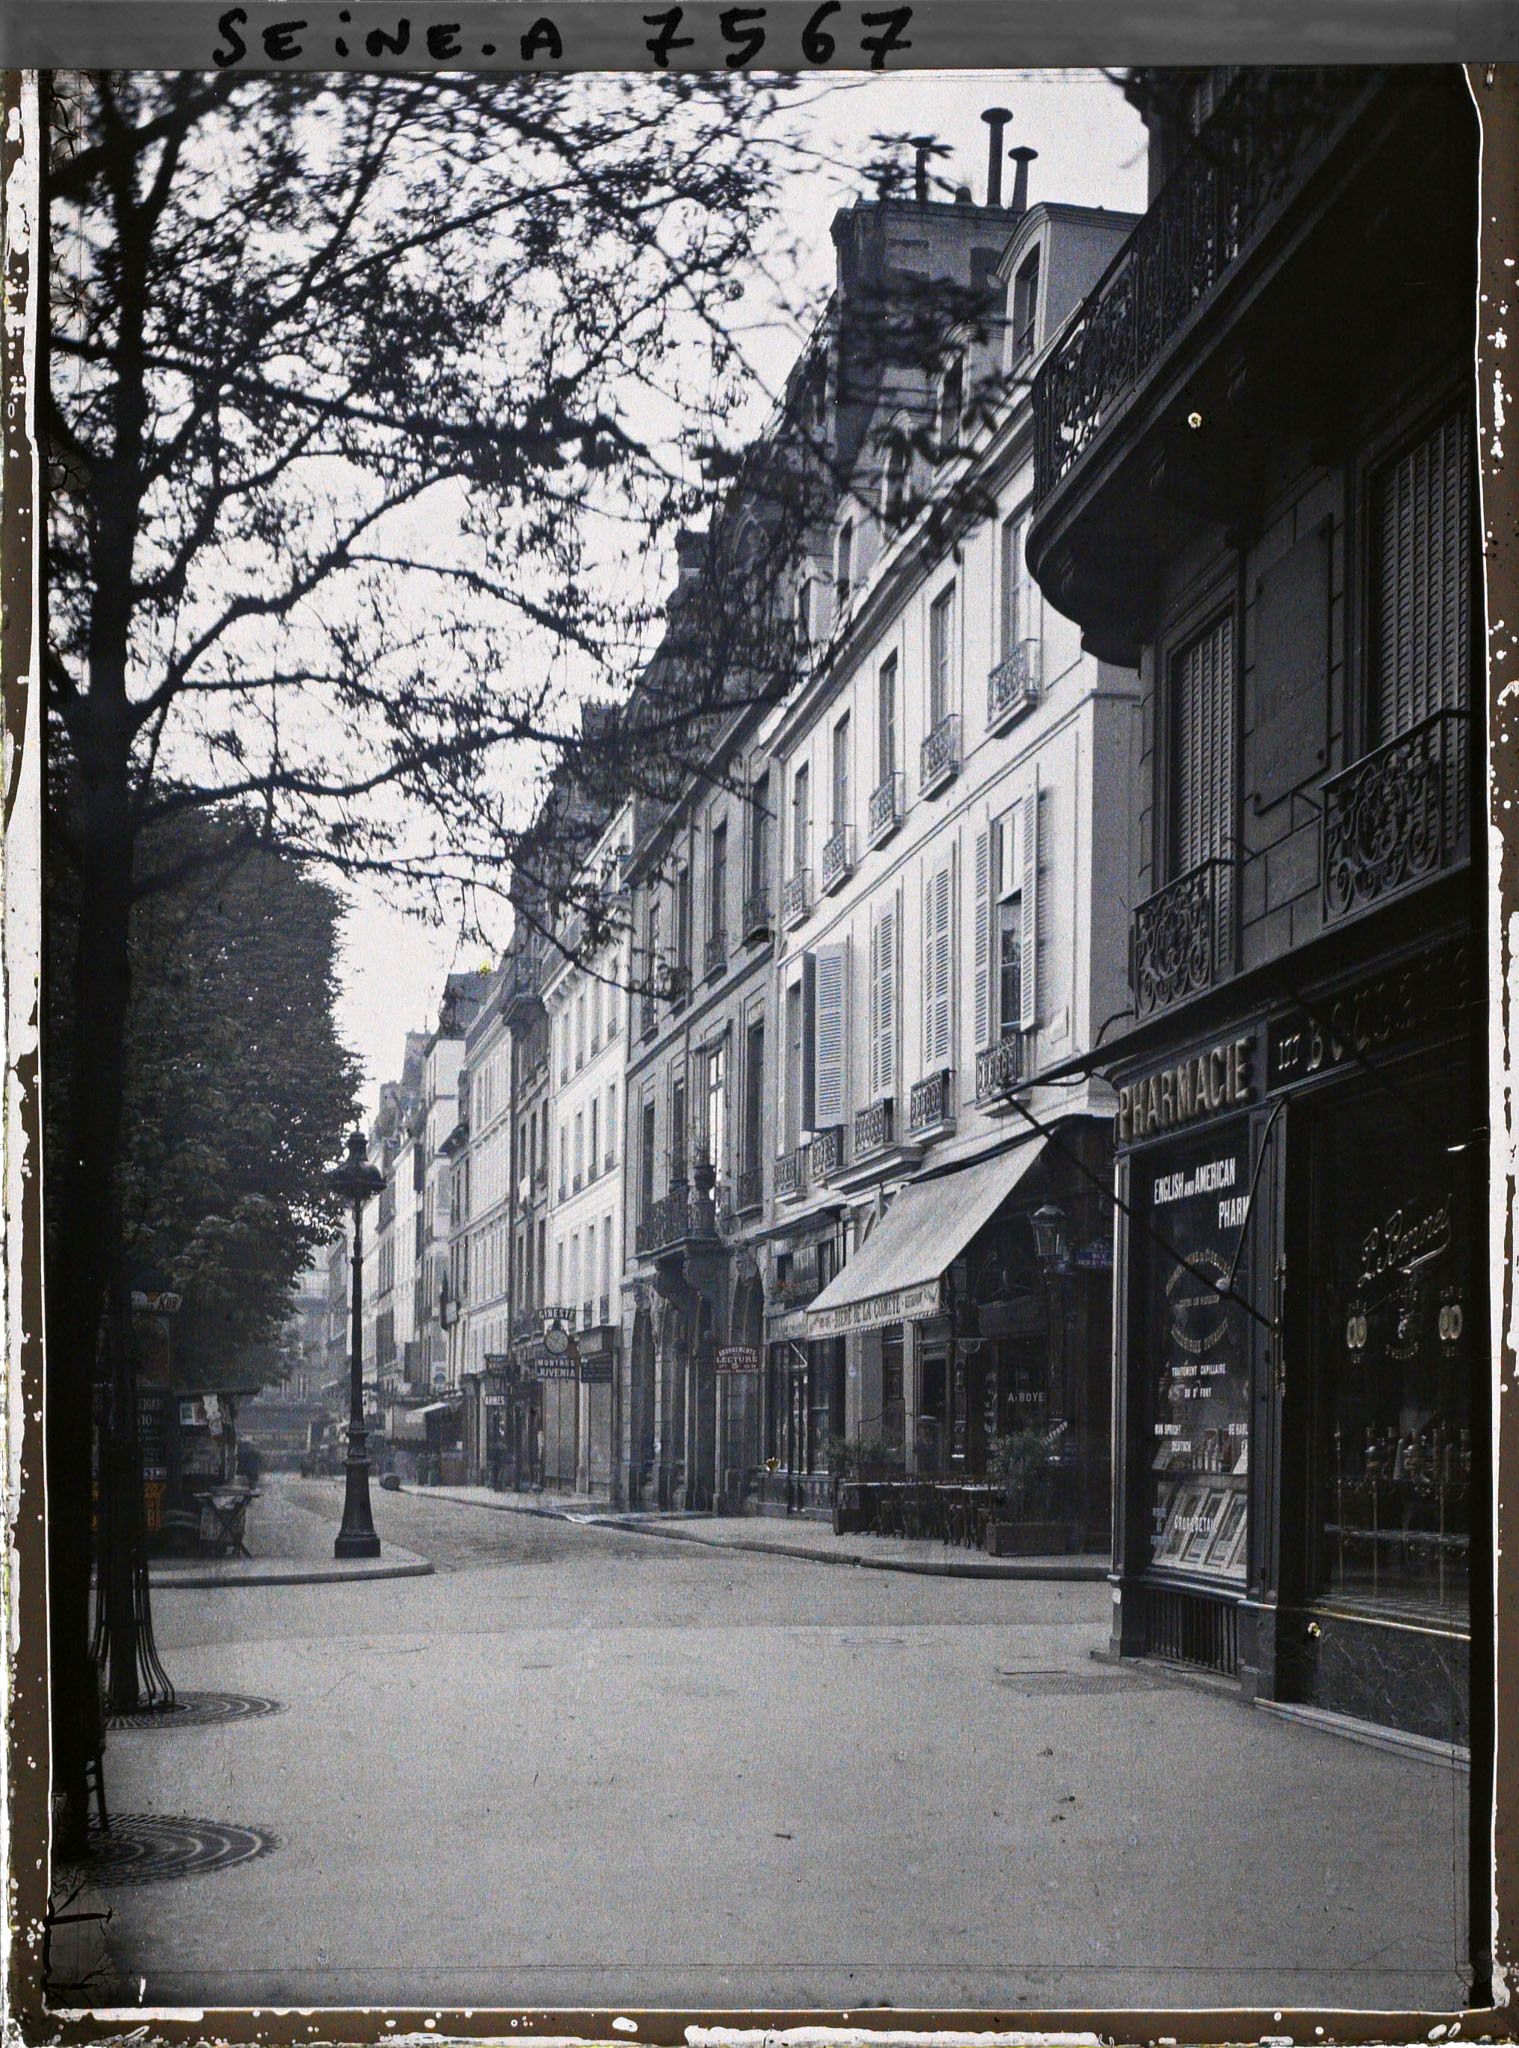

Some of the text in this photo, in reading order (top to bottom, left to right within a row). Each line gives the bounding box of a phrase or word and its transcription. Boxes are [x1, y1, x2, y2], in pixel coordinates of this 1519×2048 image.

[643, 2, 912, 70] 7567
[1119, 1036, 1253, 1141] PHARMACIE
[1154, 1171, 1184, 1205] ENGLISH
[1194, 1157, 1236, 1194] AMERICAN
[537, 1359, 575, 1367] MONTRES
[716, 1356, 758, 1364] LECTURE
[537, 1368, 576, 1377] JUVENIA
[1200, 1363, 1226, 1375] CAPILLAIRE
